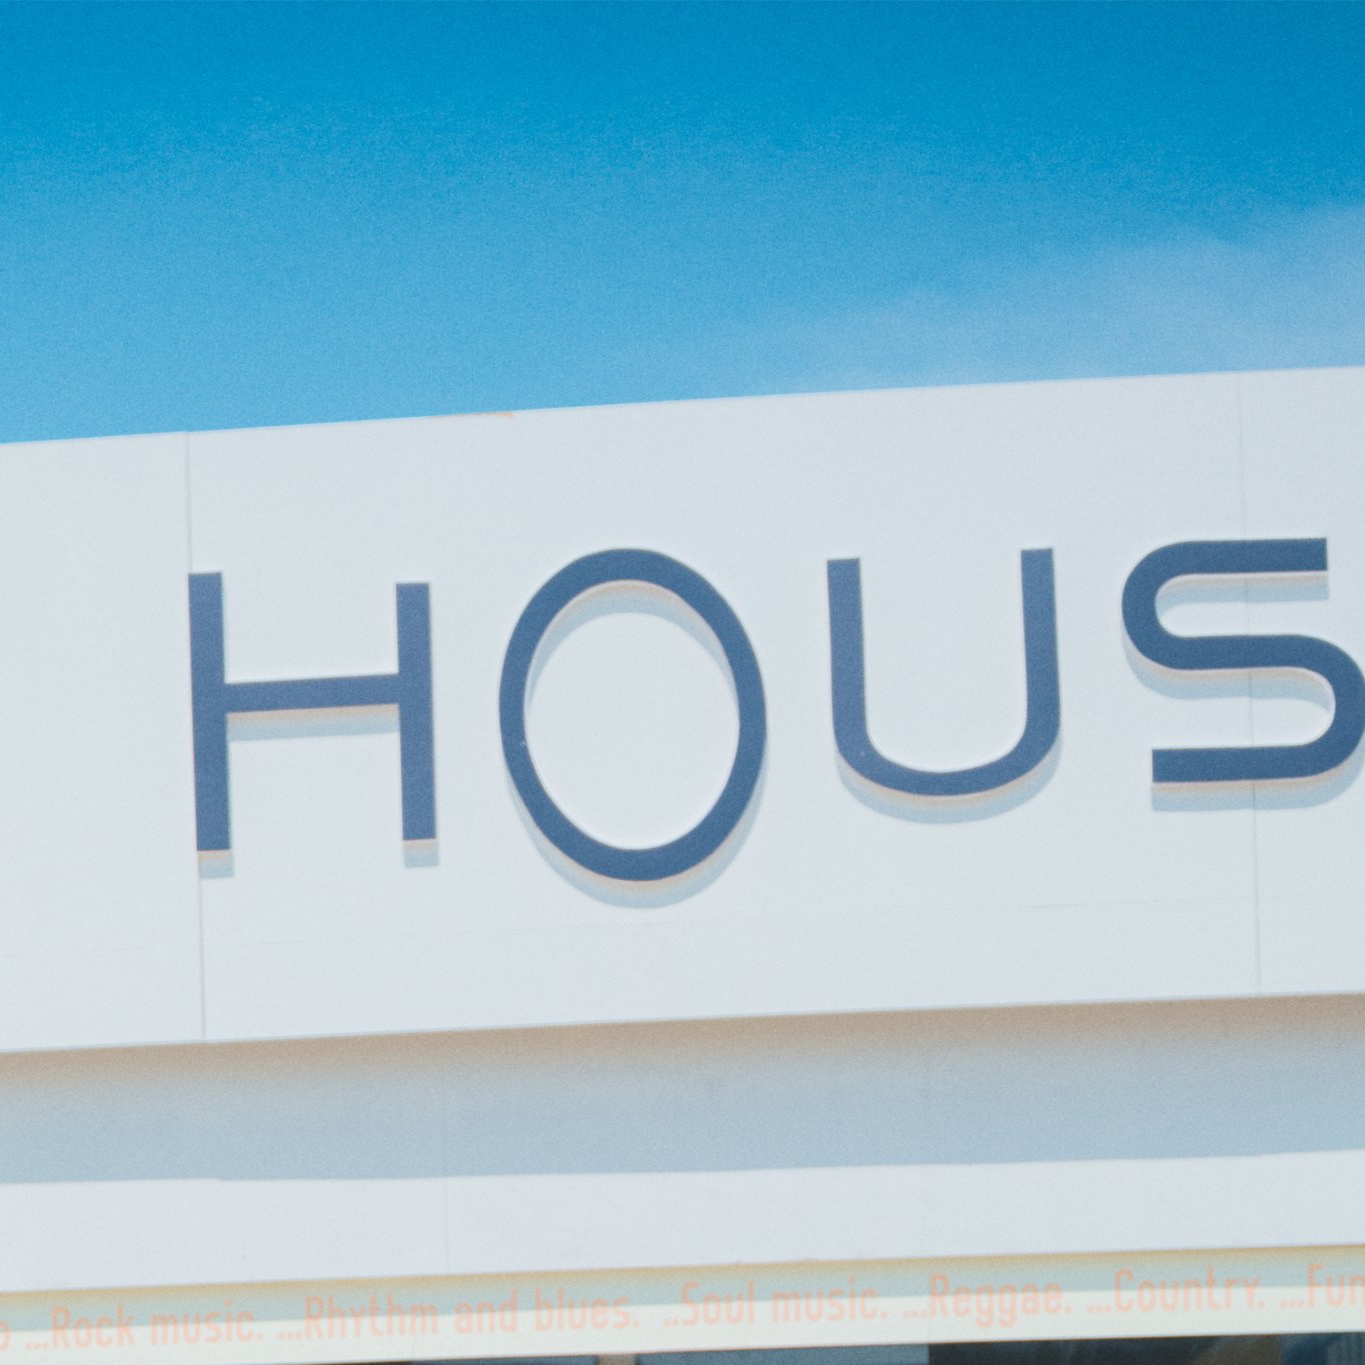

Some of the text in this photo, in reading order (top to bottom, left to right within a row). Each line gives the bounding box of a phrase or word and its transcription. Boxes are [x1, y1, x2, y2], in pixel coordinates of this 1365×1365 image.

[187, 537, 1365, 882] HOUS
[149, 1299, 264, 1346] music.
[454, 1288, 520, 1335] and
[536, 1285, 639, 1331] blues.
[771, 1274, 888, 1323] music.
